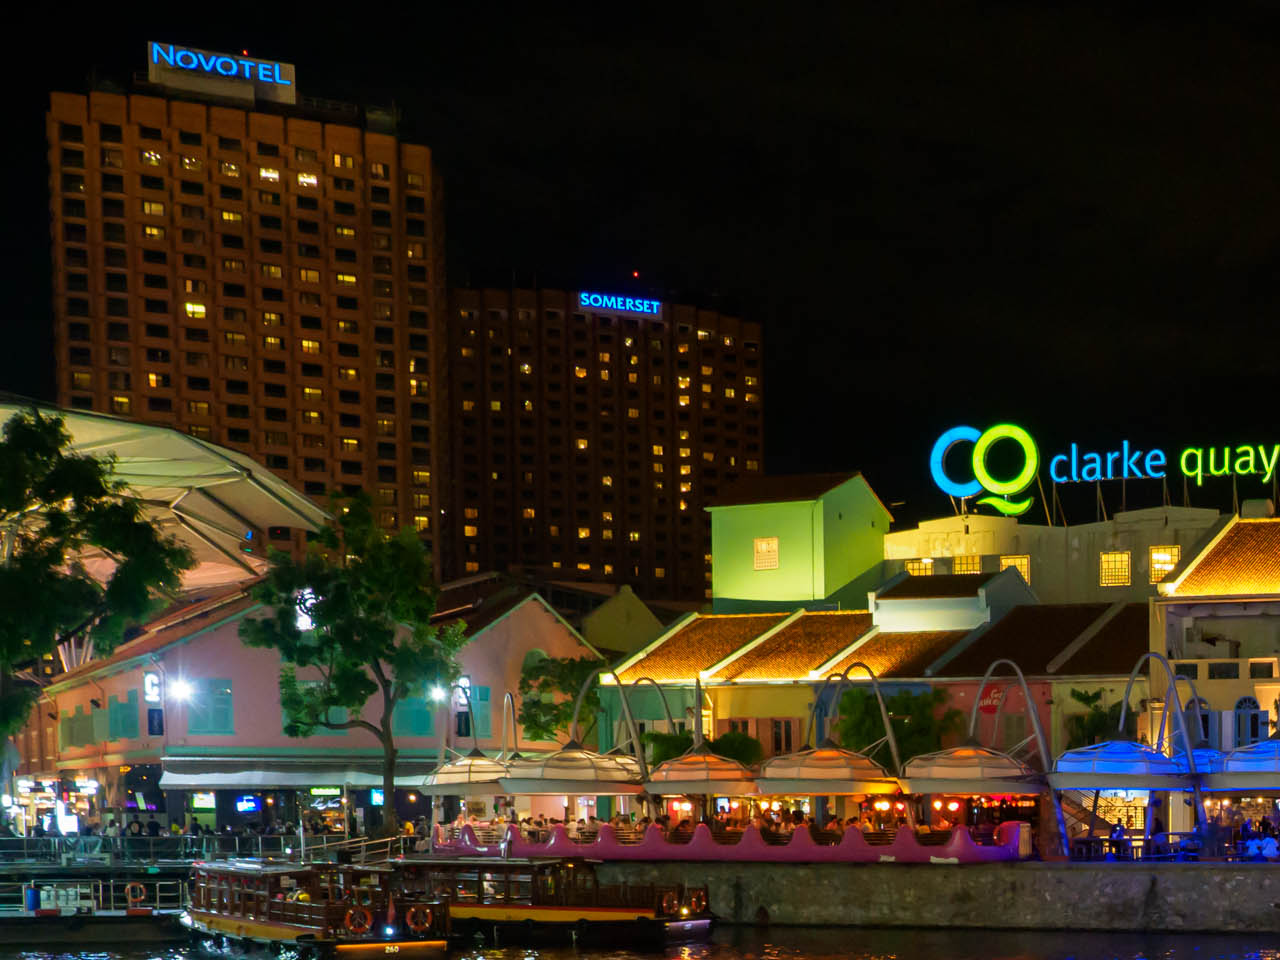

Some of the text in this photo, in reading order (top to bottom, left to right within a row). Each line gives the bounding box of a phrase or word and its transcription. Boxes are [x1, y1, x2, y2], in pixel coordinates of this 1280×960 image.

[151, 41, 292, 86] NOVOTEL
[580, 292, 661, 315] SOMERSET
[1050, 440, 1167, 483] clarke
